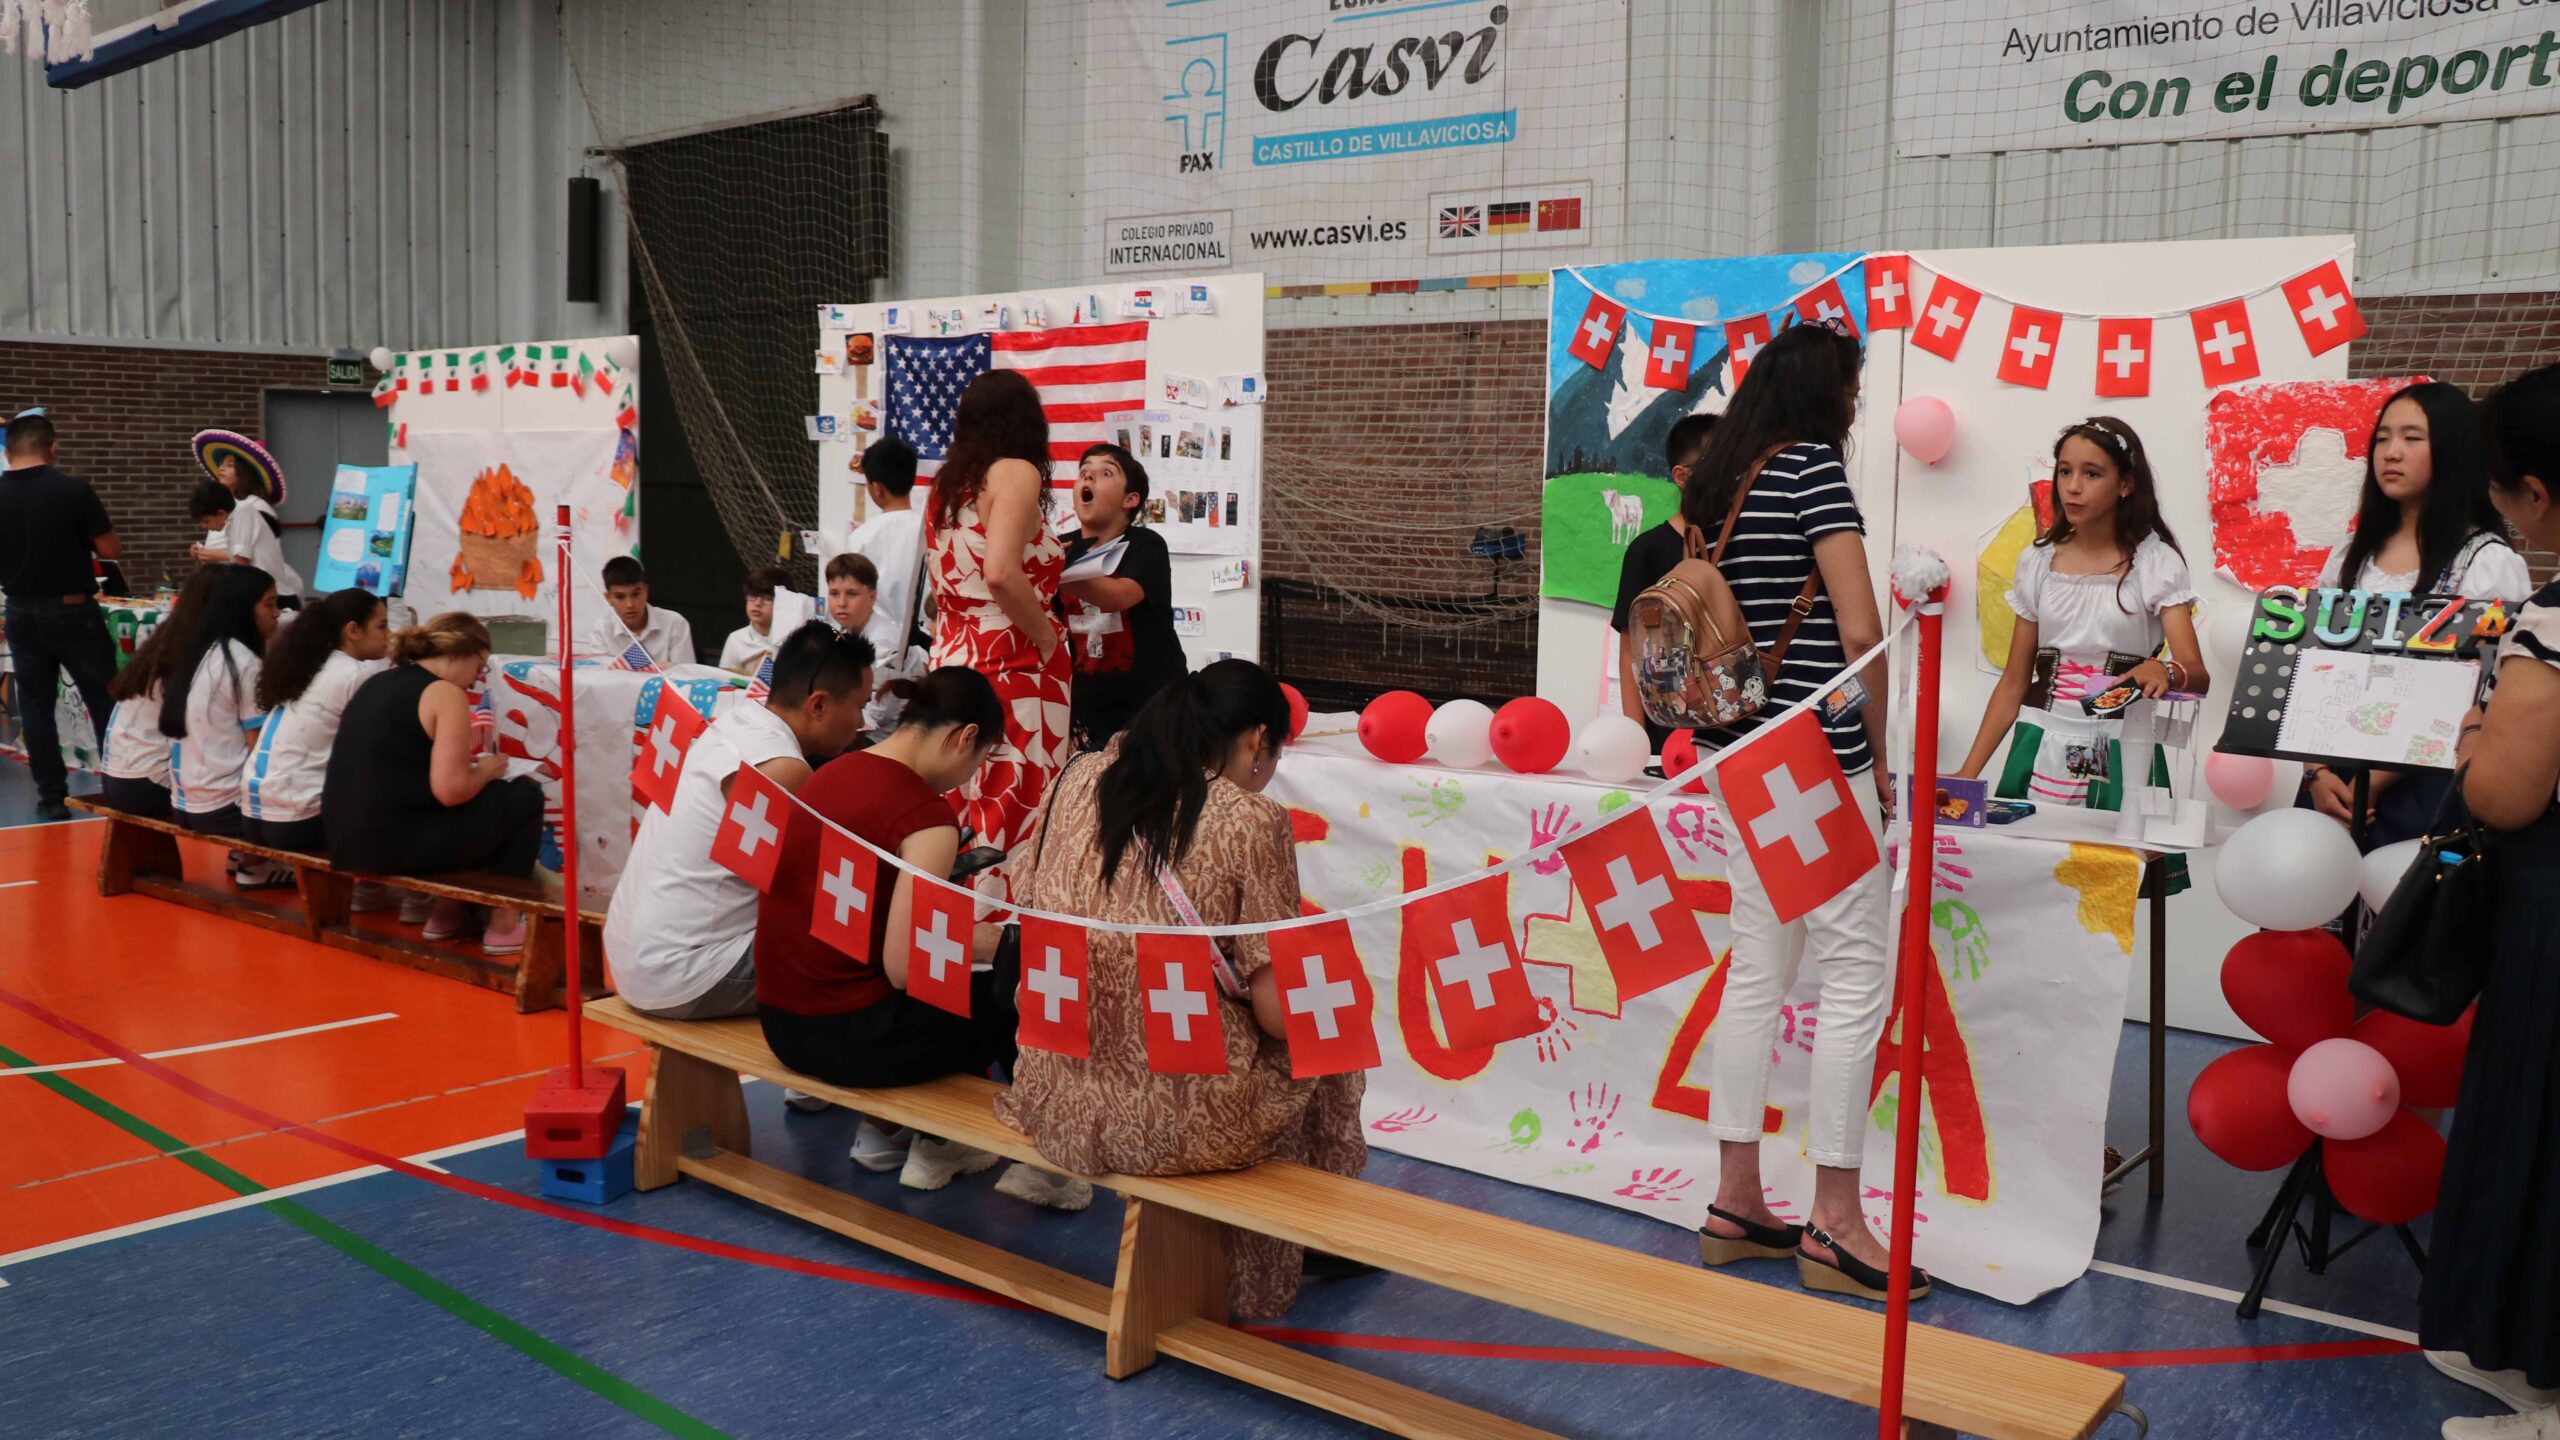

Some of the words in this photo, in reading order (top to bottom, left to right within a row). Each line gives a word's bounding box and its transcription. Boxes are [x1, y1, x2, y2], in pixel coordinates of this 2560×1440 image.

[2002, 12, 2223, 62] Ayuntamiento
[2235, 6, 2280, 37] de
[1254, 5, 1509, 112] Casvi
[2064, 69, 2191, 123] Con
[2213, 55, 2279, 113] el
[2298, 31, 2560, 114] deport
[1258, 138, 1345, 162] CASTILLO
[1349, 134, 1373, 153] DE
[1378, 121, 1510, 149] VILLAVICIOSA
[1180, 151, 1213, 174] PAX
[1121, 225, 1166, 241] COLEGIO
[1168, 221, 1214, 238] PRIVADO
[1250, 215, 1407, 249] www.casvi.es
[1110, 240, 1226, 265] INTERNACIONAL
[329, 364, 360, 380] SALIDA
[2253, 584, 2507, 656] SUIZA
